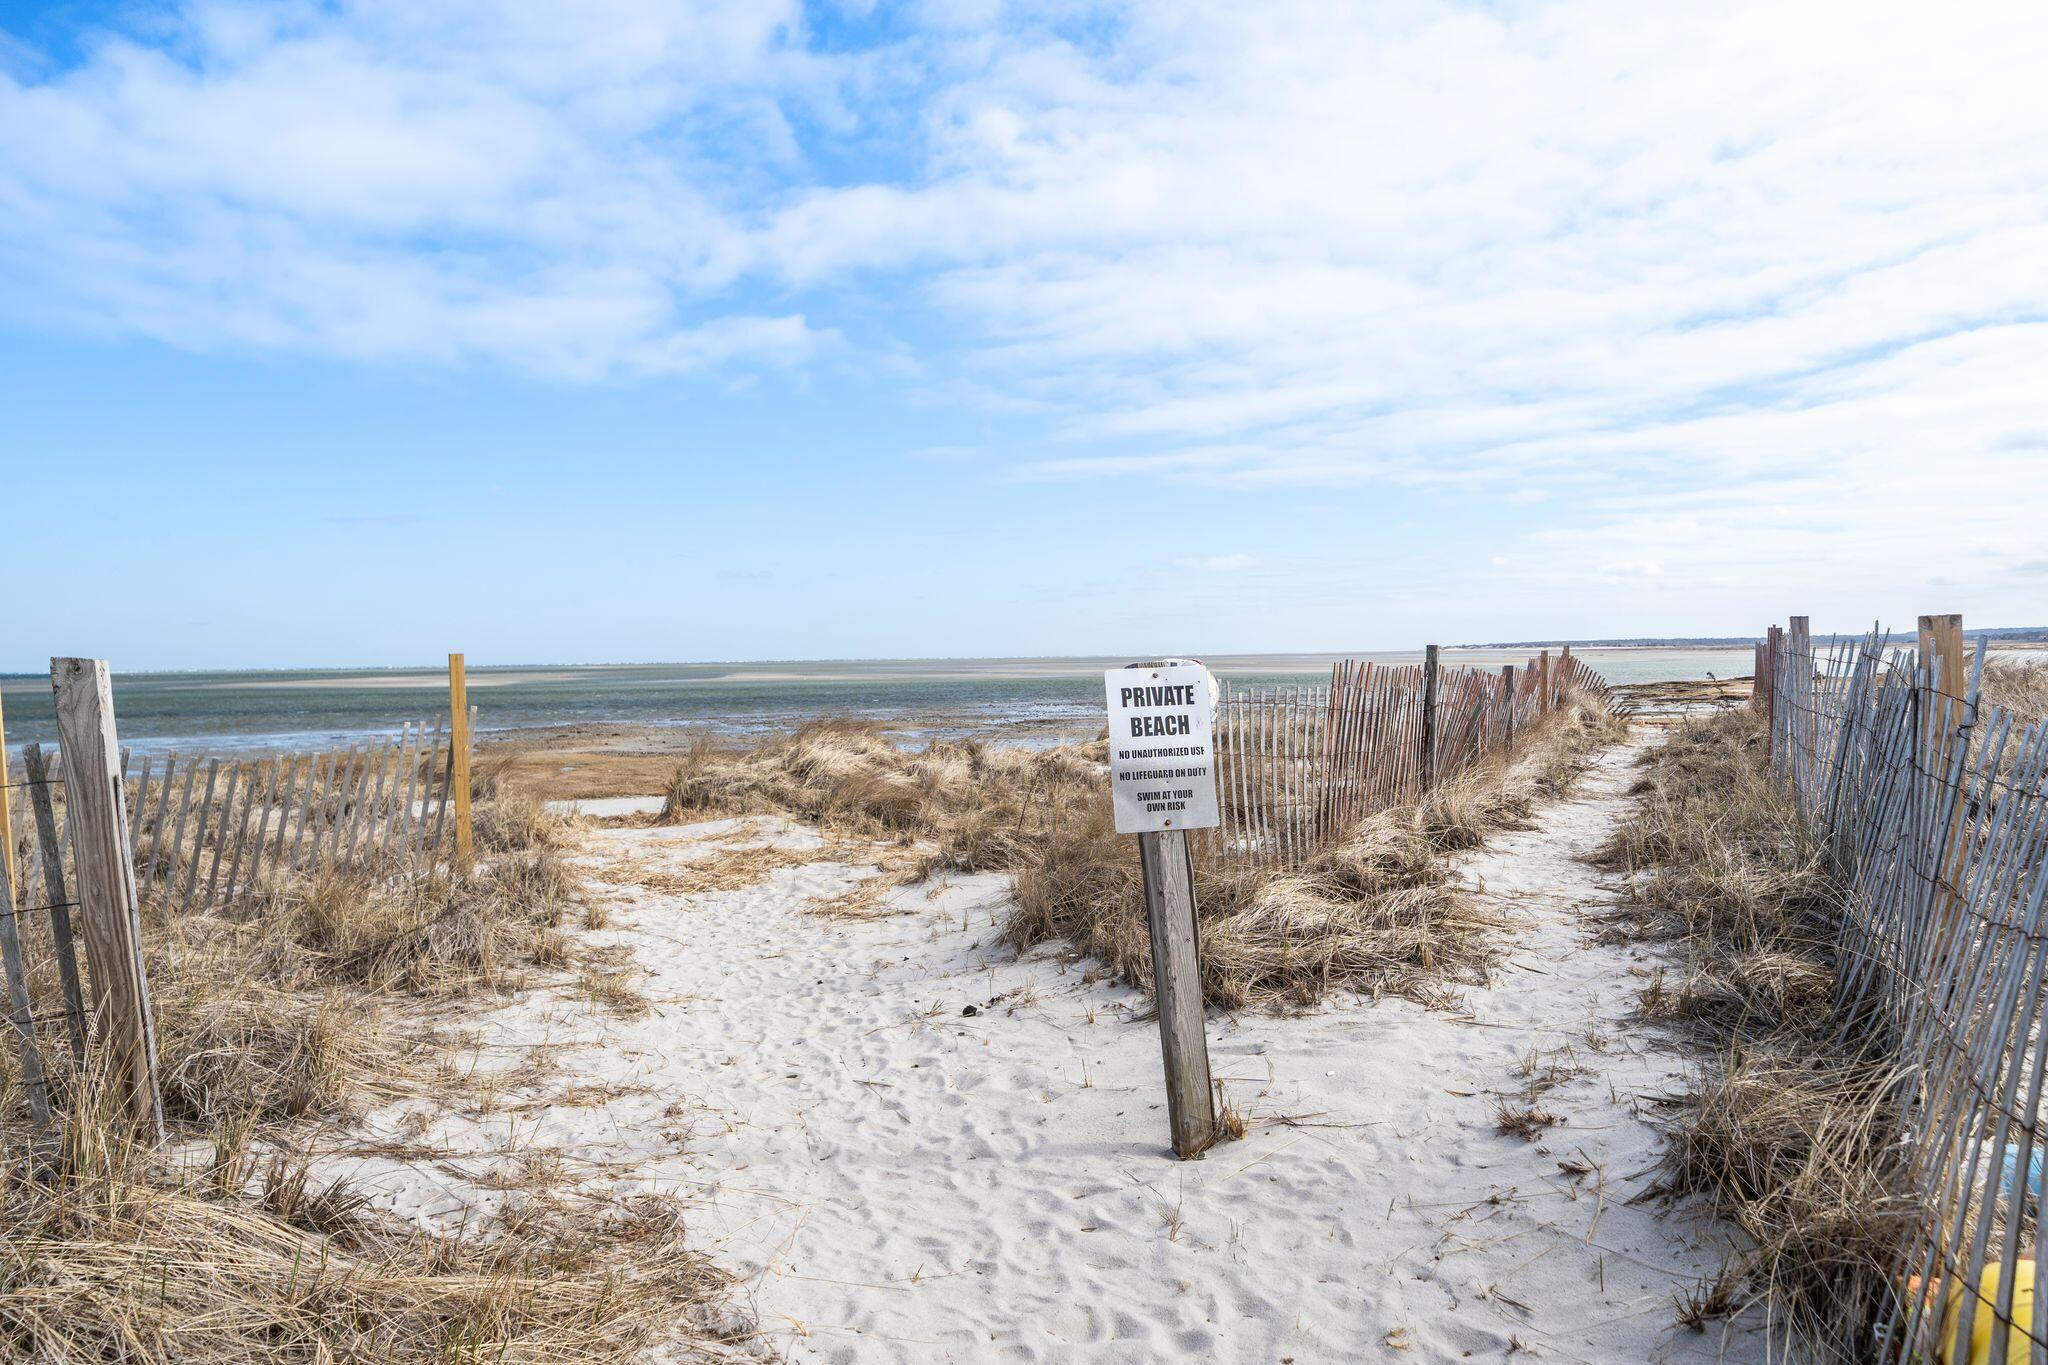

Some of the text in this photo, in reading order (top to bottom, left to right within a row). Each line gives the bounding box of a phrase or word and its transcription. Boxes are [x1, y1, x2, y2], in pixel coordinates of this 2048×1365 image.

[1121, 685, 1195, 708] PRIVATE
[1131, 715, 1190, 737] BEACH
[1119, 746, 1204, 760] NO UNAUTHORIZED USE
[1120, 767, 1207, 781] NO LIFEGUARD ON DUTY
[1137, 789, 1193, 802] SWIM AT YOUR
[1147, 801, 1186, 813] OWN RISK
